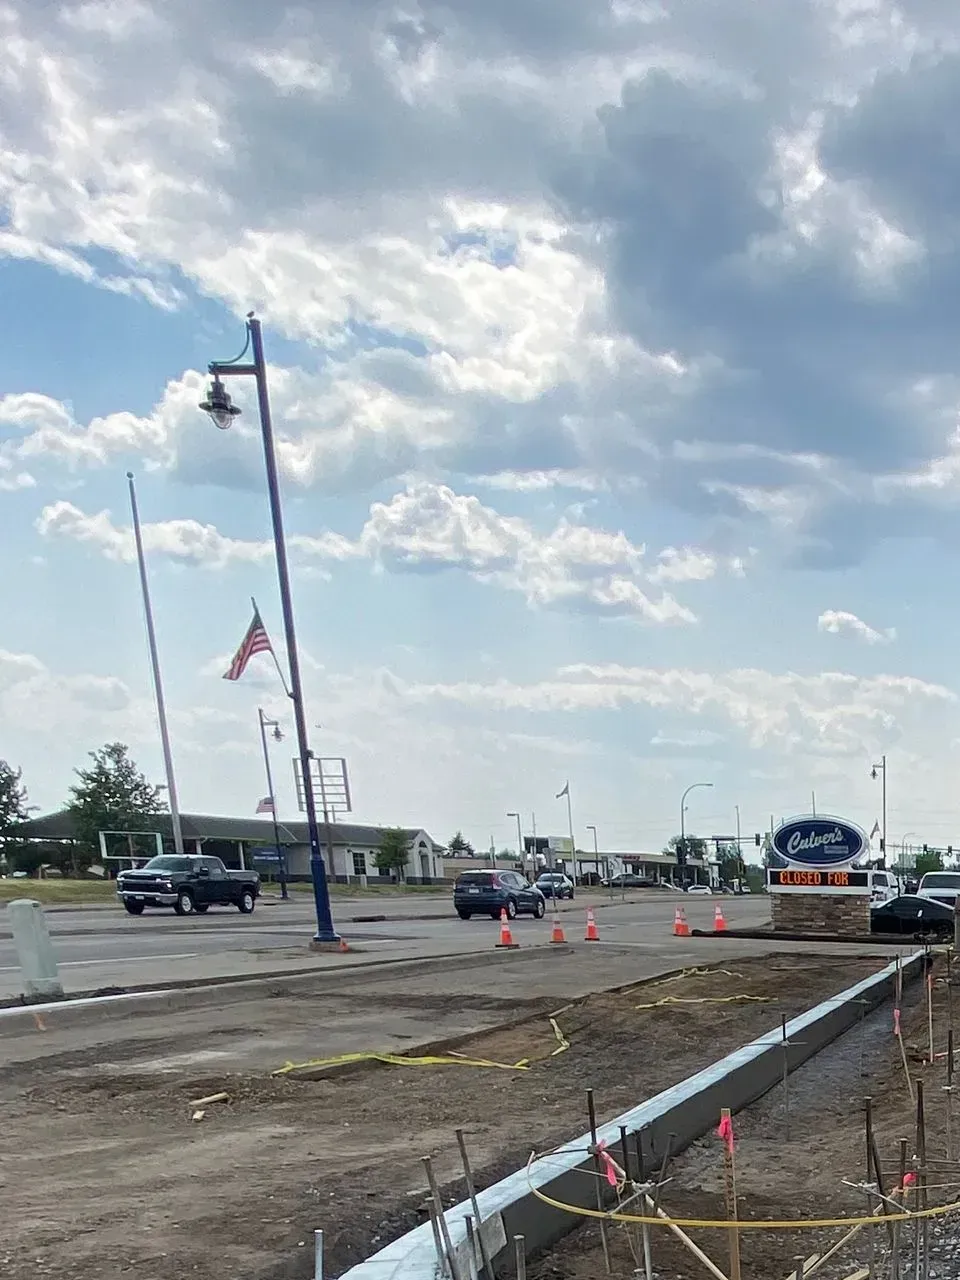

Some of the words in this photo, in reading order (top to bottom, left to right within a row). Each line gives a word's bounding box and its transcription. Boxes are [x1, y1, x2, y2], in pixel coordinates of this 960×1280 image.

[787, 827, 843, 854] Culver's
[780, 871, 821, 885] CLOSED
[827, 872, 849, 885] FOR
